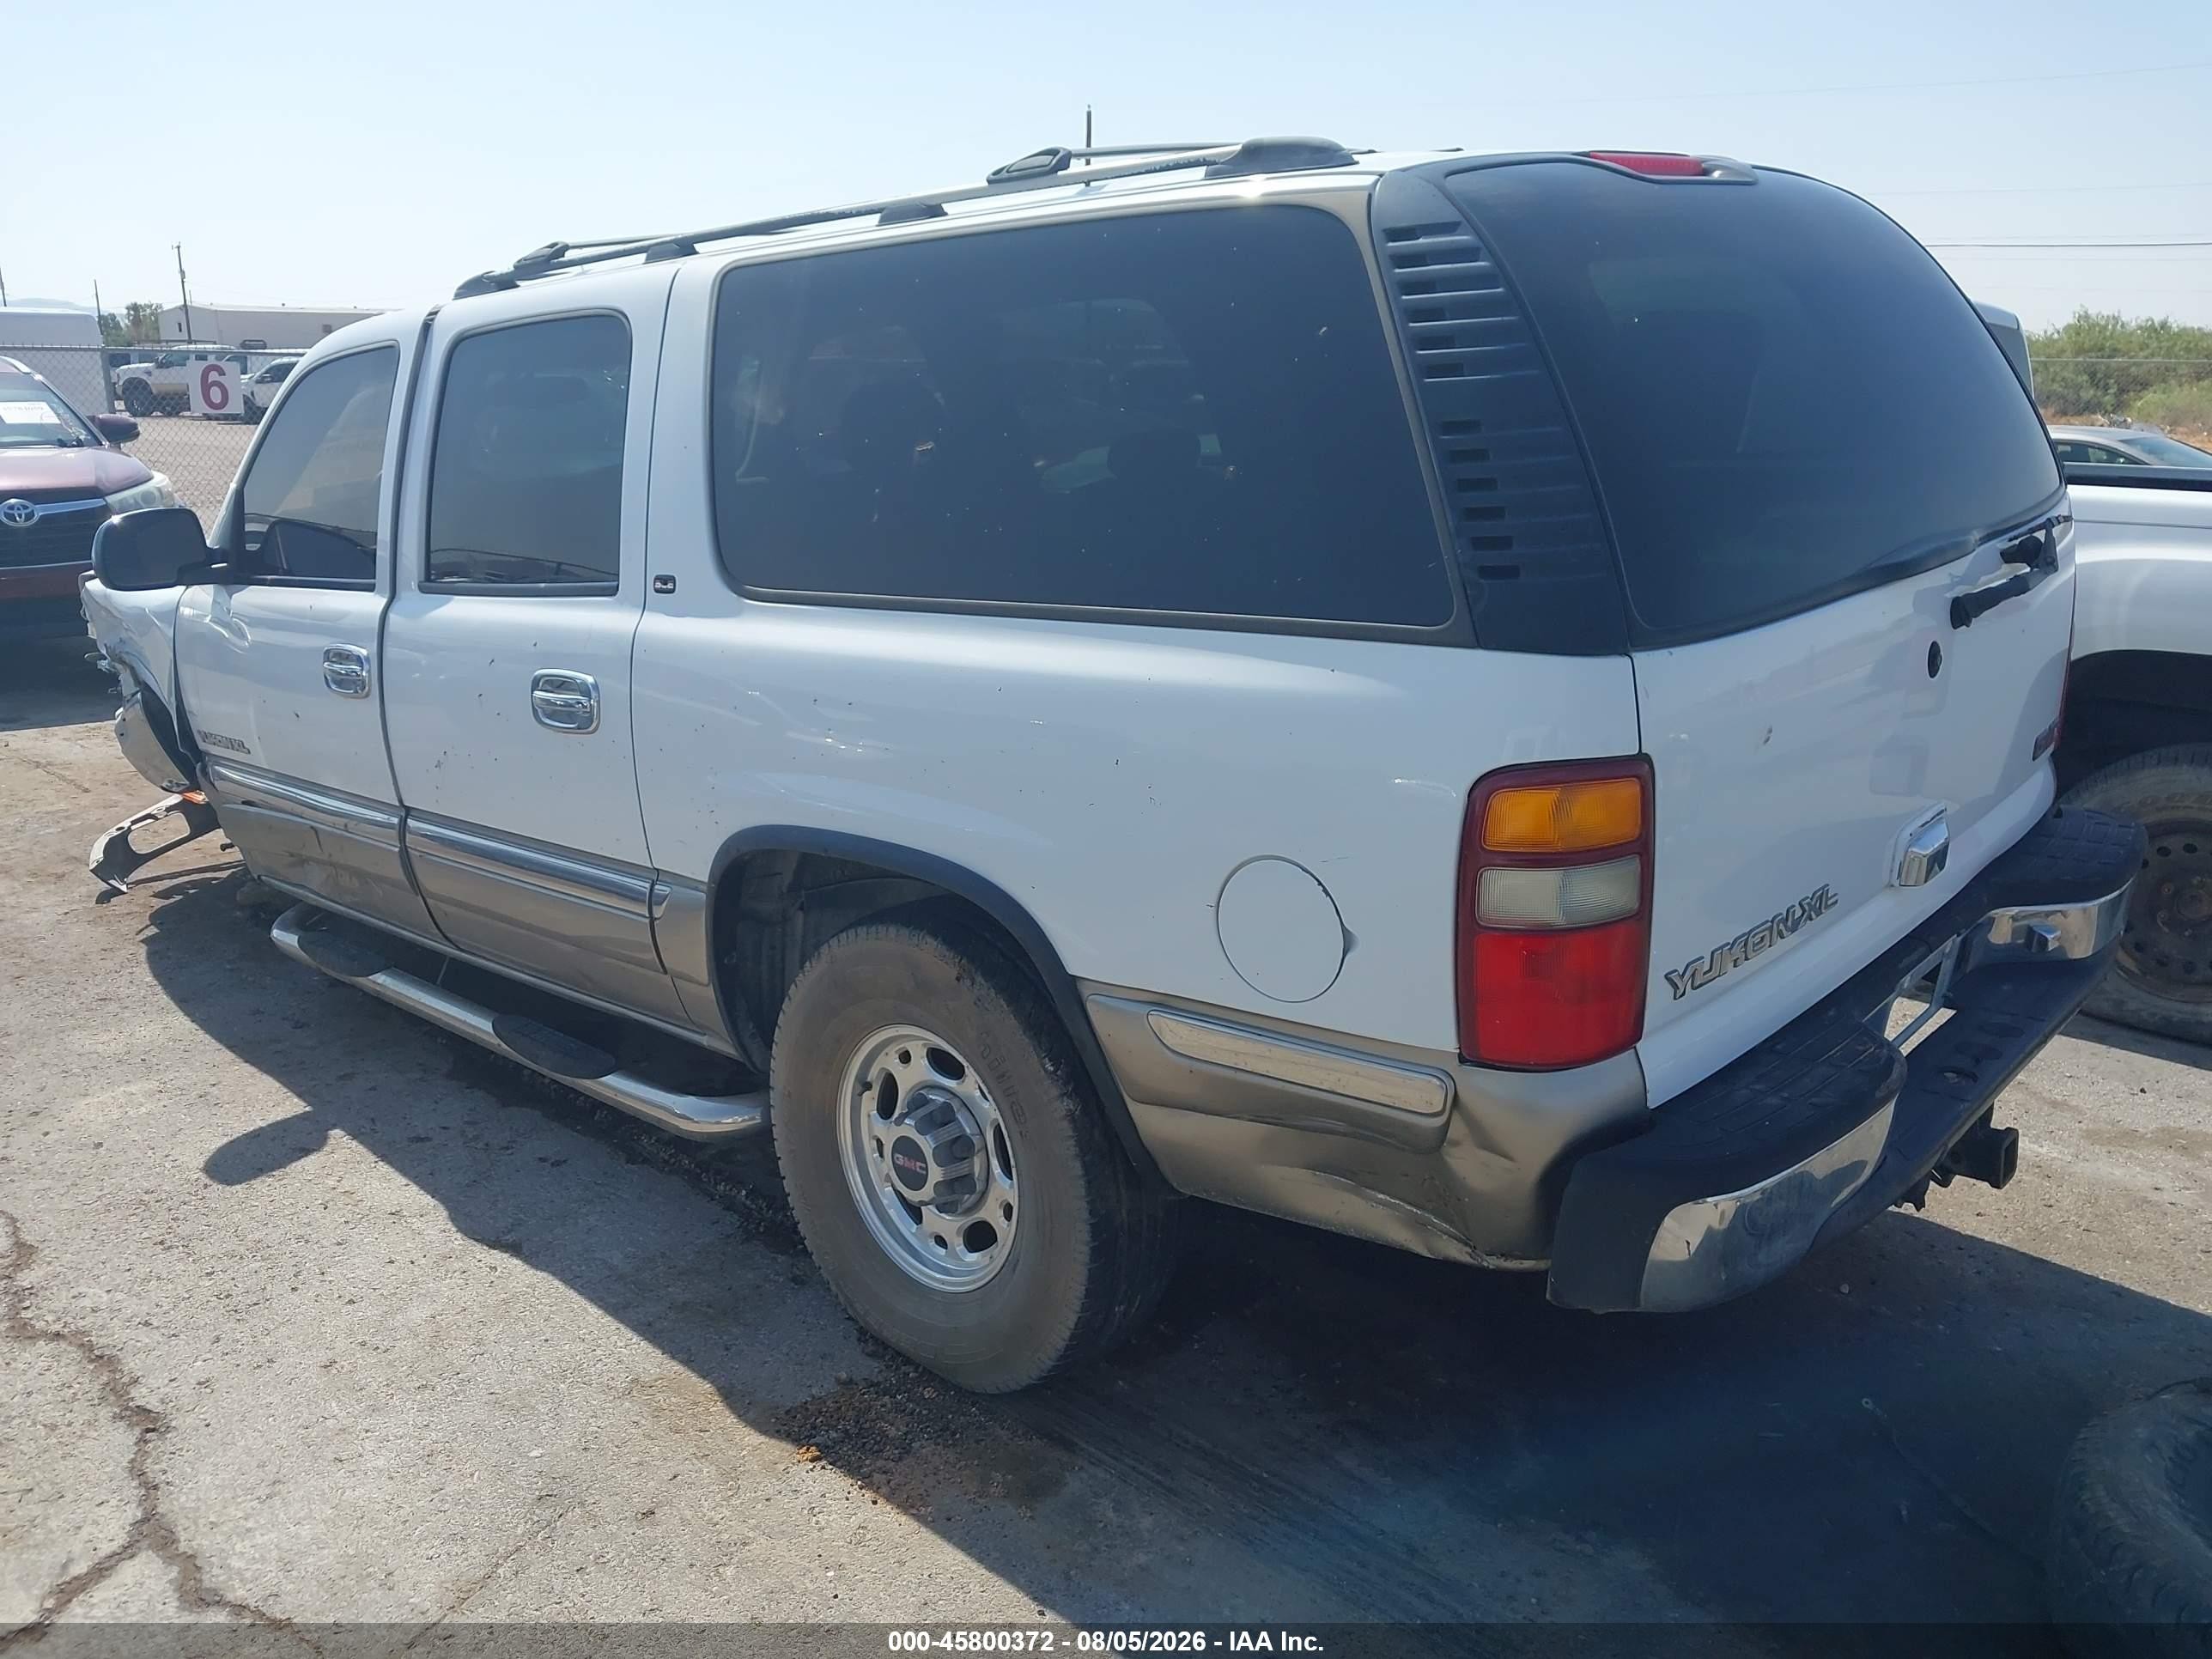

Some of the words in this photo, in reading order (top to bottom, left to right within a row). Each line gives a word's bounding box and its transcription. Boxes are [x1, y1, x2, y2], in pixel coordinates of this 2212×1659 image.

[199, 363, 229, 410] 6
[1664, 905, 1796, 1000] YUKON
[1797, 884, 1838, 929] XL
[893, 1152, 927, 1175] GMC
